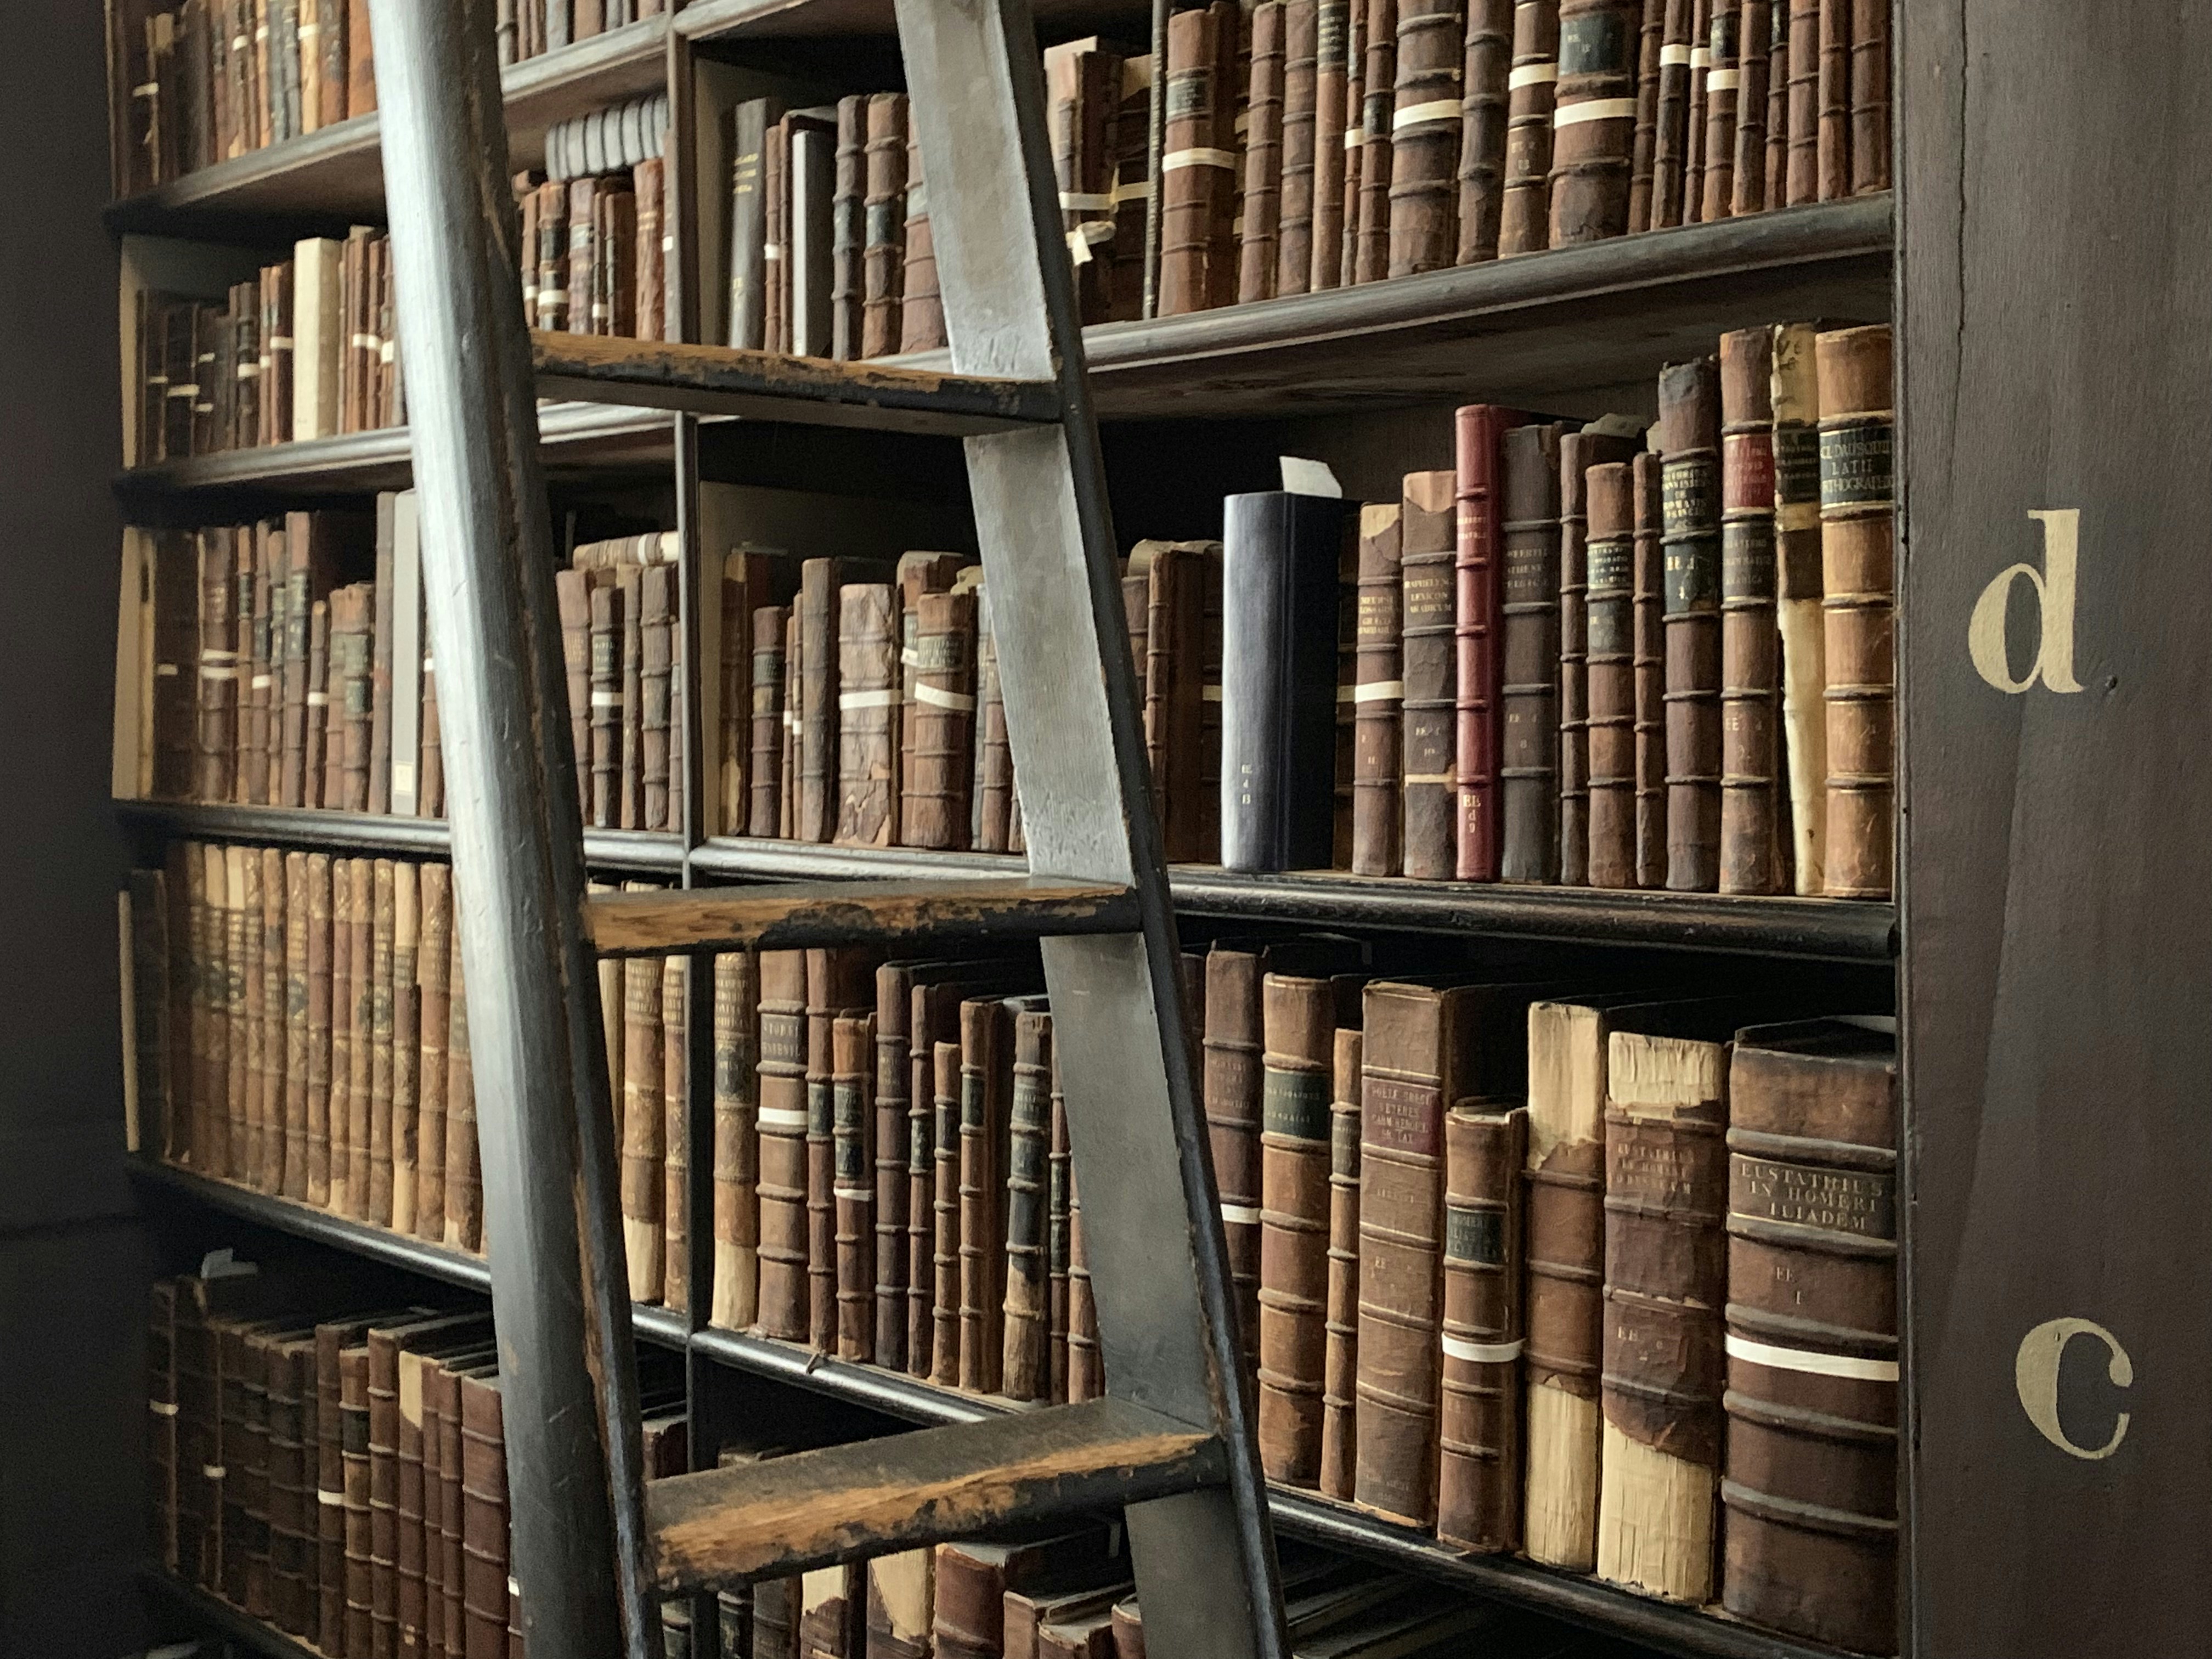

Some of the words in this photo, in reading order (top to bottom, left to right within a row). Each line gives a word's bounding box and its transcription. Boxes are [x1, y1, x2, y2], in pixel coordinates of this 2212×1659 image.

[1968, 508, 2084, 694] d
[1468, 809, 1476, 821] d
[2016, 1317, 2133, 1459] c
